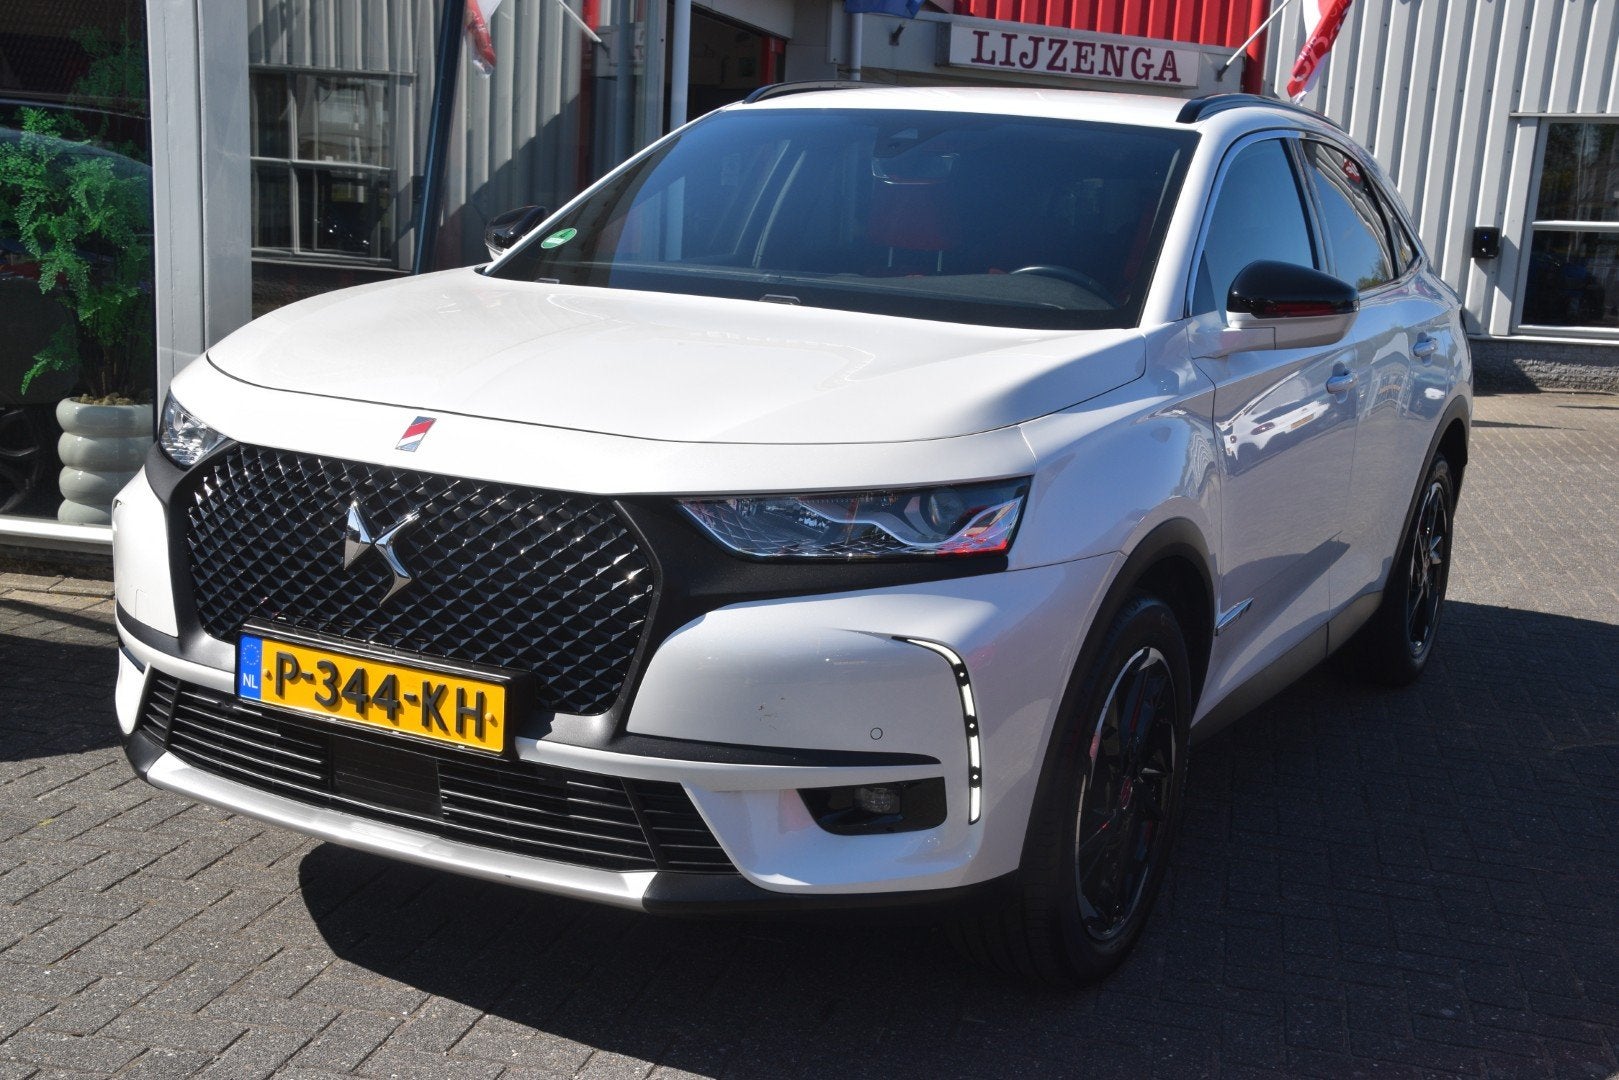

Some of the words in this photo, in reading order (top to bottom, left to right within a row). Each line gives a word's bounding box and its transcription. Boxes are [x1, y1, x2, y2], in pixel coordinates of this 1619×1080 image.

[971, 30, 1181, 82] LIJZENGA
[242, 672, 258, 689] NL
[275, 651, 484, 738] P-344-KH
